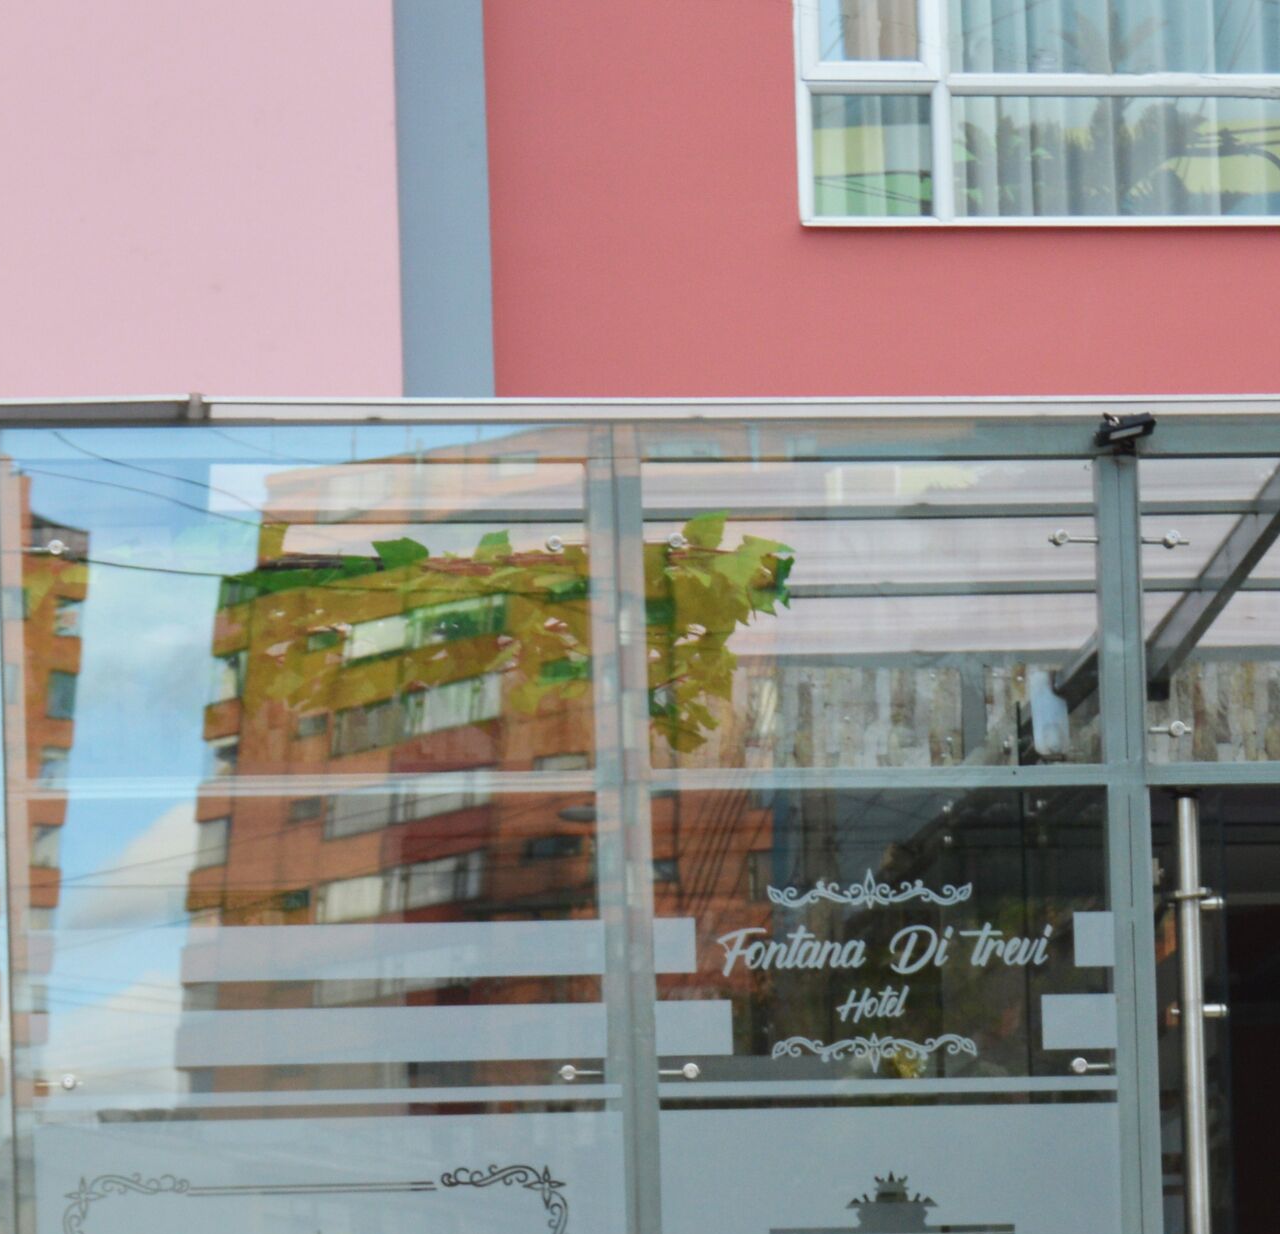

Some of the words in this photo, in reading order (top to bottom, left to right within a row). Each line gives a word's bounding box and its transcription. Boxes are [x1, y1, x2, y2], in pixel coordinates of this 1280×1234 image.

[717, 924, 867, 977] Fontana
[889, 924, 954, 975] Di
[836, 984, 909, 1023] Hotel
